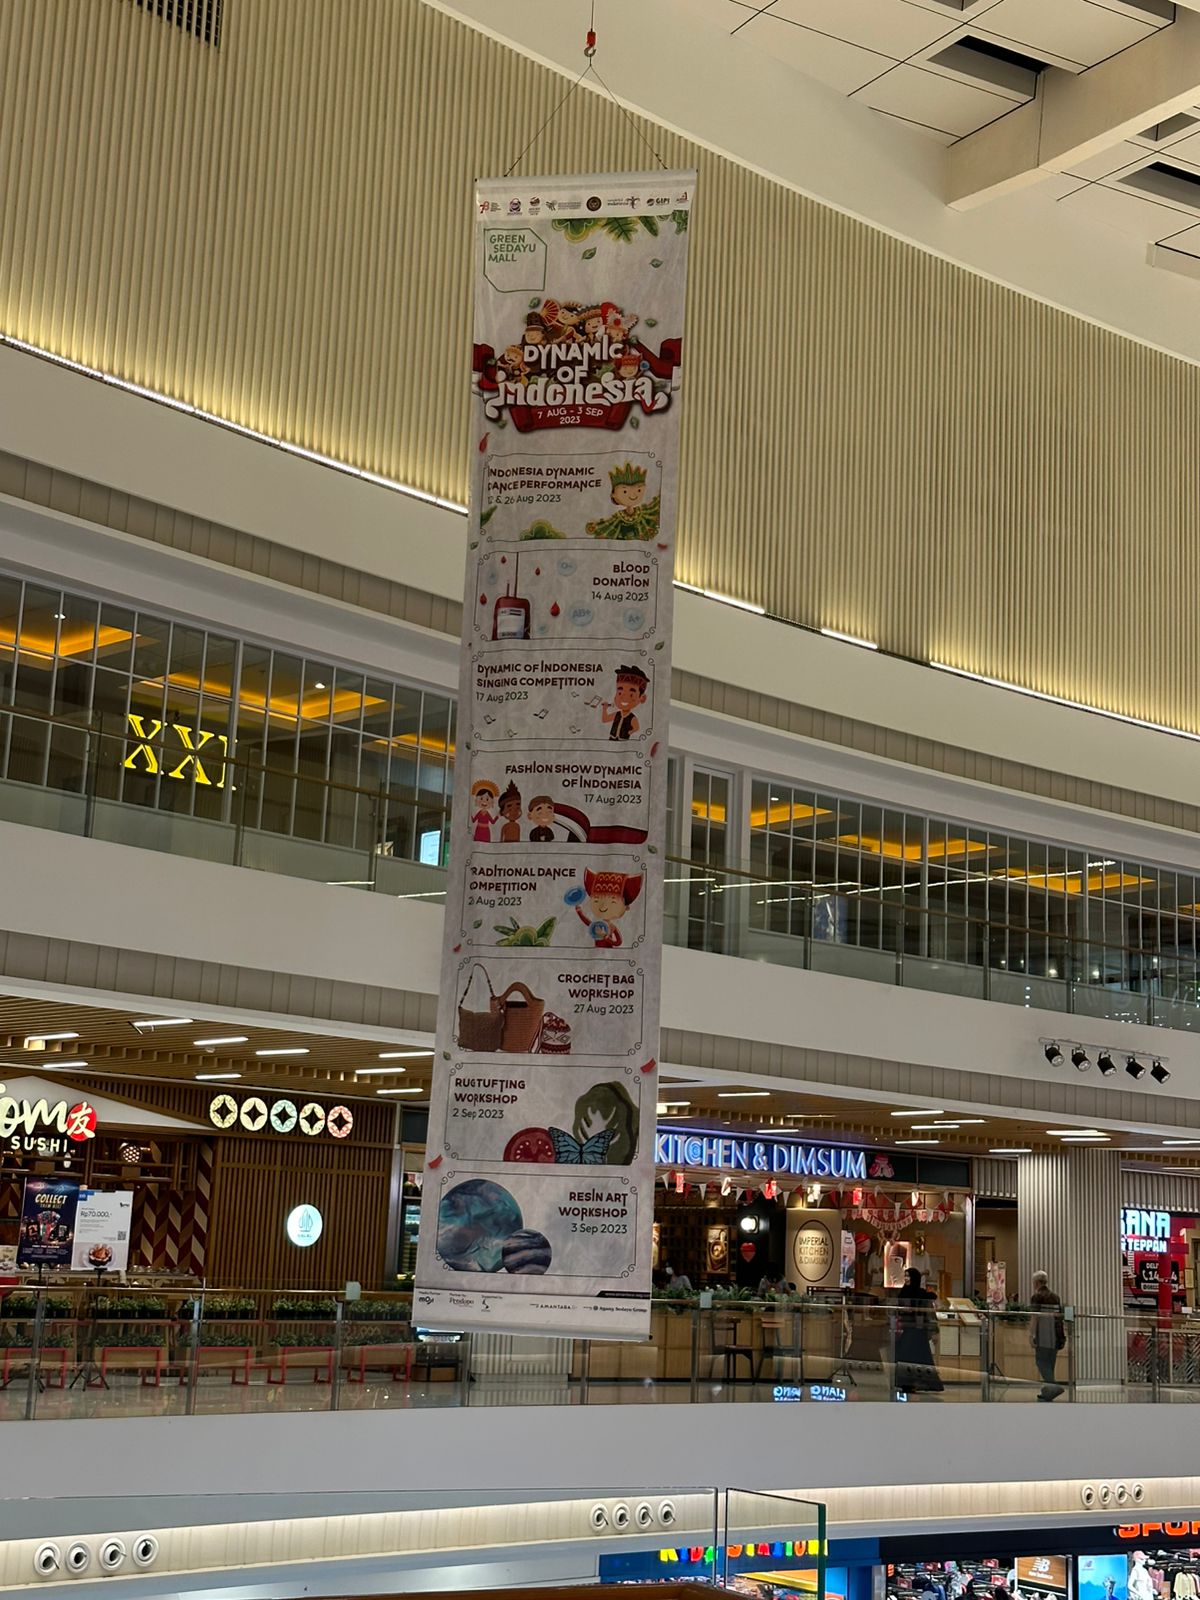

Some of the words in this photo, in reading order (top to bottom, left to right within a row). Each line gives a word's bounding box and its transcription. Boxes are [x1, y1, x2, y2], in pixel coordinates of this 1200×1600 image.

[489, 235, 525, 244] GREEN
[493, 243, 536, 253] SEDAYU
[488, 253, 517, 263] MALL
[523, 334, 624, 370] DYNAMIC
[556, 365, 589, 384] OF
[537, 411, 543, 419] 7
[546, 408, 567, 417] AUG
[577, 407, 583, 415] 3
[584, 407, 604, 416] SEP
[559, 416, 581, 424] 2023
[545, 467, 595, 479] DYNAMIC
[520, 479, 602, 492] PERFORMANCE
[516, 495, 534, 504] Aug
[536, 494, 561, 503] 2023
[613, 561, 650, 574] BLOOD
[592, 575, 650, 588] DONATION
[591, 591, 602, 600] 14
[604, 592, 623, 602] Aug
[626, 591, 649, 601] 2023
[477, 663, 521, 677] DYNAMIC
[524, 663, 539, 673] OF
[540, 660, 603, 673] INDONESIA
[476, 677, 517, 688] SINGING
[519, 677, 595, 689] COMPETITION
[476, 692, 484, 701] 17
[486, 693, 504, 703] Aug
[505, 691, 529, 701] 2023
[123, 713, 237, 791] XXI
[505, 761, 552, 774] FASHION
[554, 764, 591, 774] SHOW
[594, 765, 642, 778] DYNAMIC
[562, 778, 578, 788] OF
[579, 775, 642, 789] INDONESIA
[584, 793, 594, 803] 17
[597, 794, 615, 806] Aug
[616, 794, 642, 804] 2023
[470, 864, 536, 877] RADITIONAL
[537, 868, 576, 880] DANCE
[469, 881, 537, 895] OMPETITION
[475, 896, 495, 908] Aug
[498, 896, 522, 906] 2023
[557, 973, 610, 987] CROCHET
[612, 974, 635, 984] BAG
[568, 988, 635, 1001] WORKSHOP
[574, 1004, 585, 1013] 27
[587, 1004, 606, 1016] Aug
[609, 1004, 634, 1014] 2023
[454, 1093, 518, 1106] WORKSHOP
[0, 1083, 68, 1138] om
[452, 1108, 459, 1117] 2
[462, 1108, 477, 1119] Sep
[478, 1108, 504, 1119] 2023
[66, 1101, 96, 1138] 友
[11, 1135, 68, 1153] SUSHI
[654, 1133, 748, 1170] KITCHEN
[752, 1142, 769, 1172] &
[773, 1144, 867, 1180] DIMSUM
[35, 1193, 68, 1204] COLLECT
[569, 1188, 603, 1202] RESIN
[605, 1192, 628, 1206] ART
[558, 1206, 628, 1221] WORKSHOP
[571, 1223, 578, 1232] 3
[579, 1223, 598, 1235] Sep
[600, 1223, 628, 1234] 2023
[799, 1236, 829, 1246] IMPERIAL
[1128, 1238, 1167, 1252] TEPPAN
[799, 1246, 829, 1256] KITCHEN
